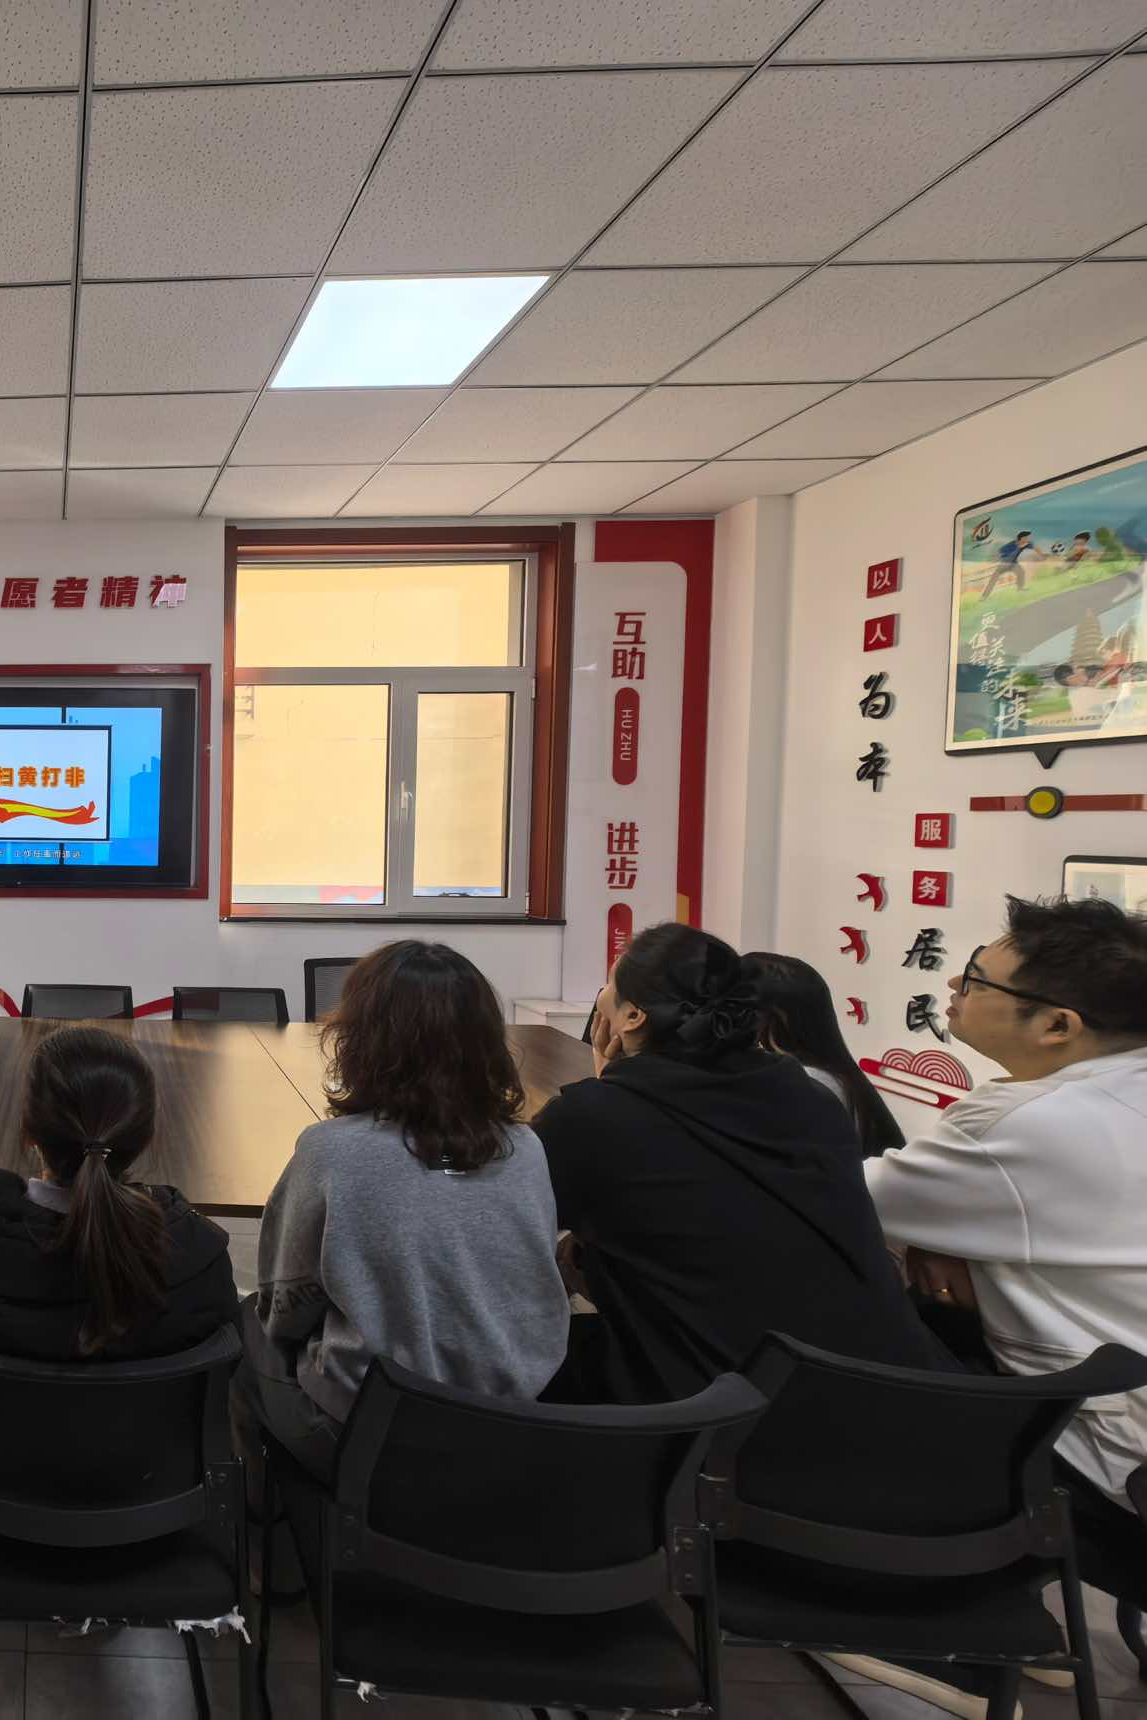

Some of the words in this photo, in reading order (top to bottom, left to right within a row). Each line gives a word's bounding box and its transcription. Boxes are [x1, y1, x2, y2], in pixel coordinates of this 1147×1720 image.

[611, 612, 646, 680] 互助
[856, 570, 892, 793] 以人为本
[620, 733, 632, 760] ZHU
[621, 709, 633, 728] HU
[605, 822, 640, 890] 进步
[902, 819, 945, 1043] 服务居民
